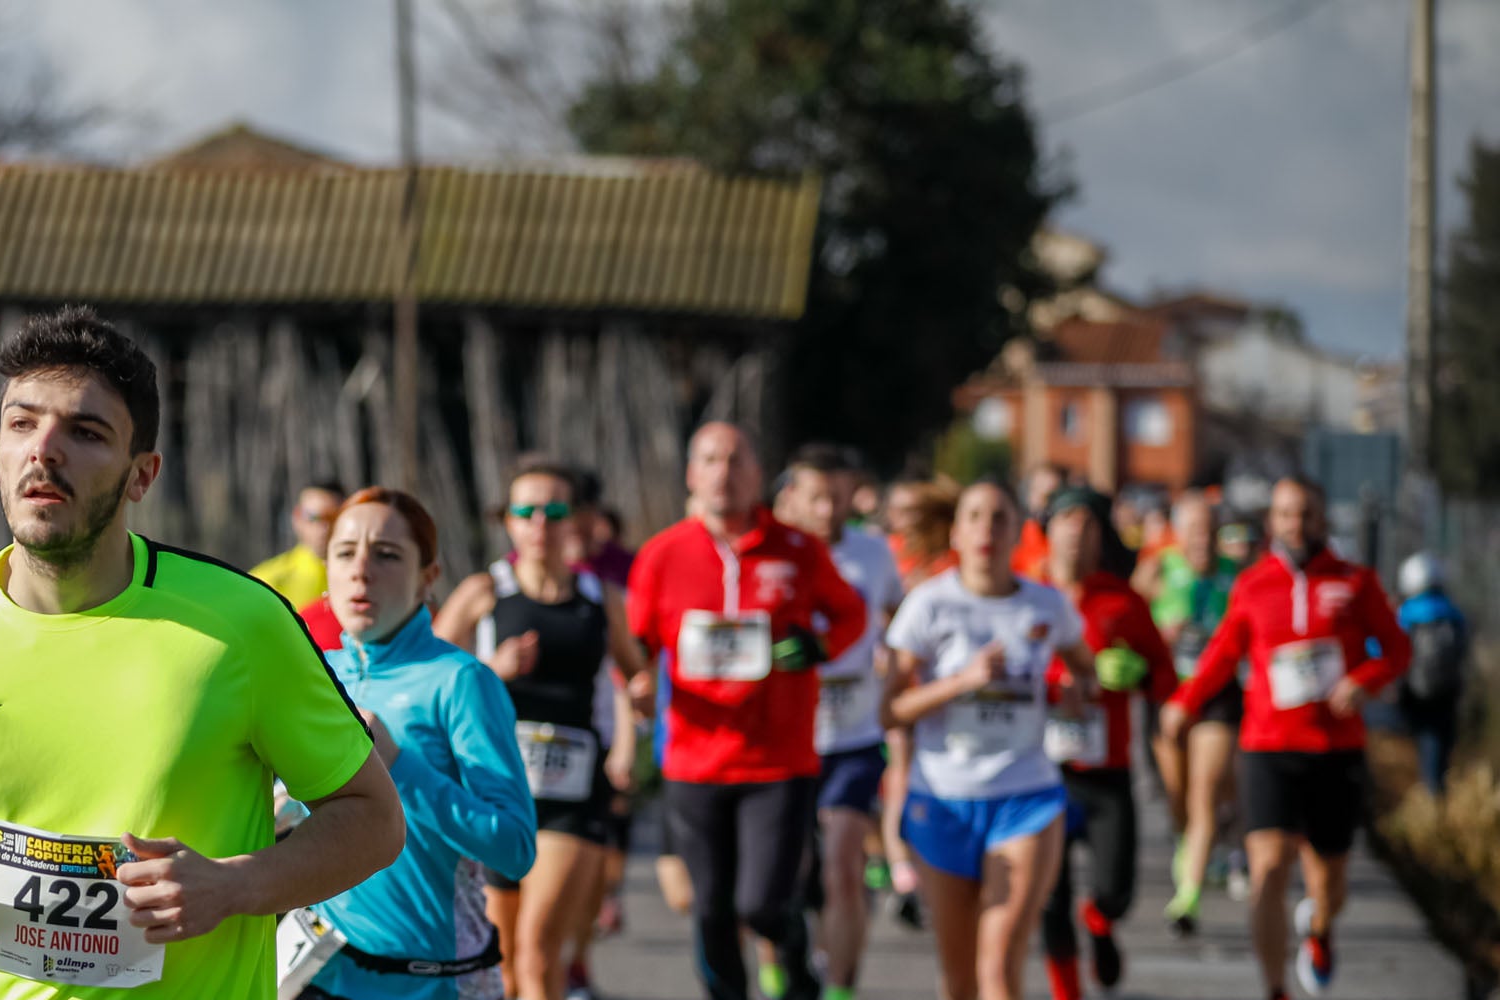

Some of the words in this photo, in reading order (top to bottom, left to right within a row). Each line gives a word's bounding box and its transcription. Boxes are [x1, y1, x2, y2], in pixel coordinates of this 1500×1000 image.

[14, 833, 27, 855] VII
[26, 836, 93, 856] CARRERA
[1, 852, 11, 861] de
[11, 854, 22, 864] los
[22, 856, 60, 872] Secaderos
[26, 848, 93, 865] POPULAR
[13, 875, 119, 930] 422
[14, 924, 47, 949] JOSE
[50, 930, 119, 955] ANTONIO
[56, 957, 96, 969] olimpo
